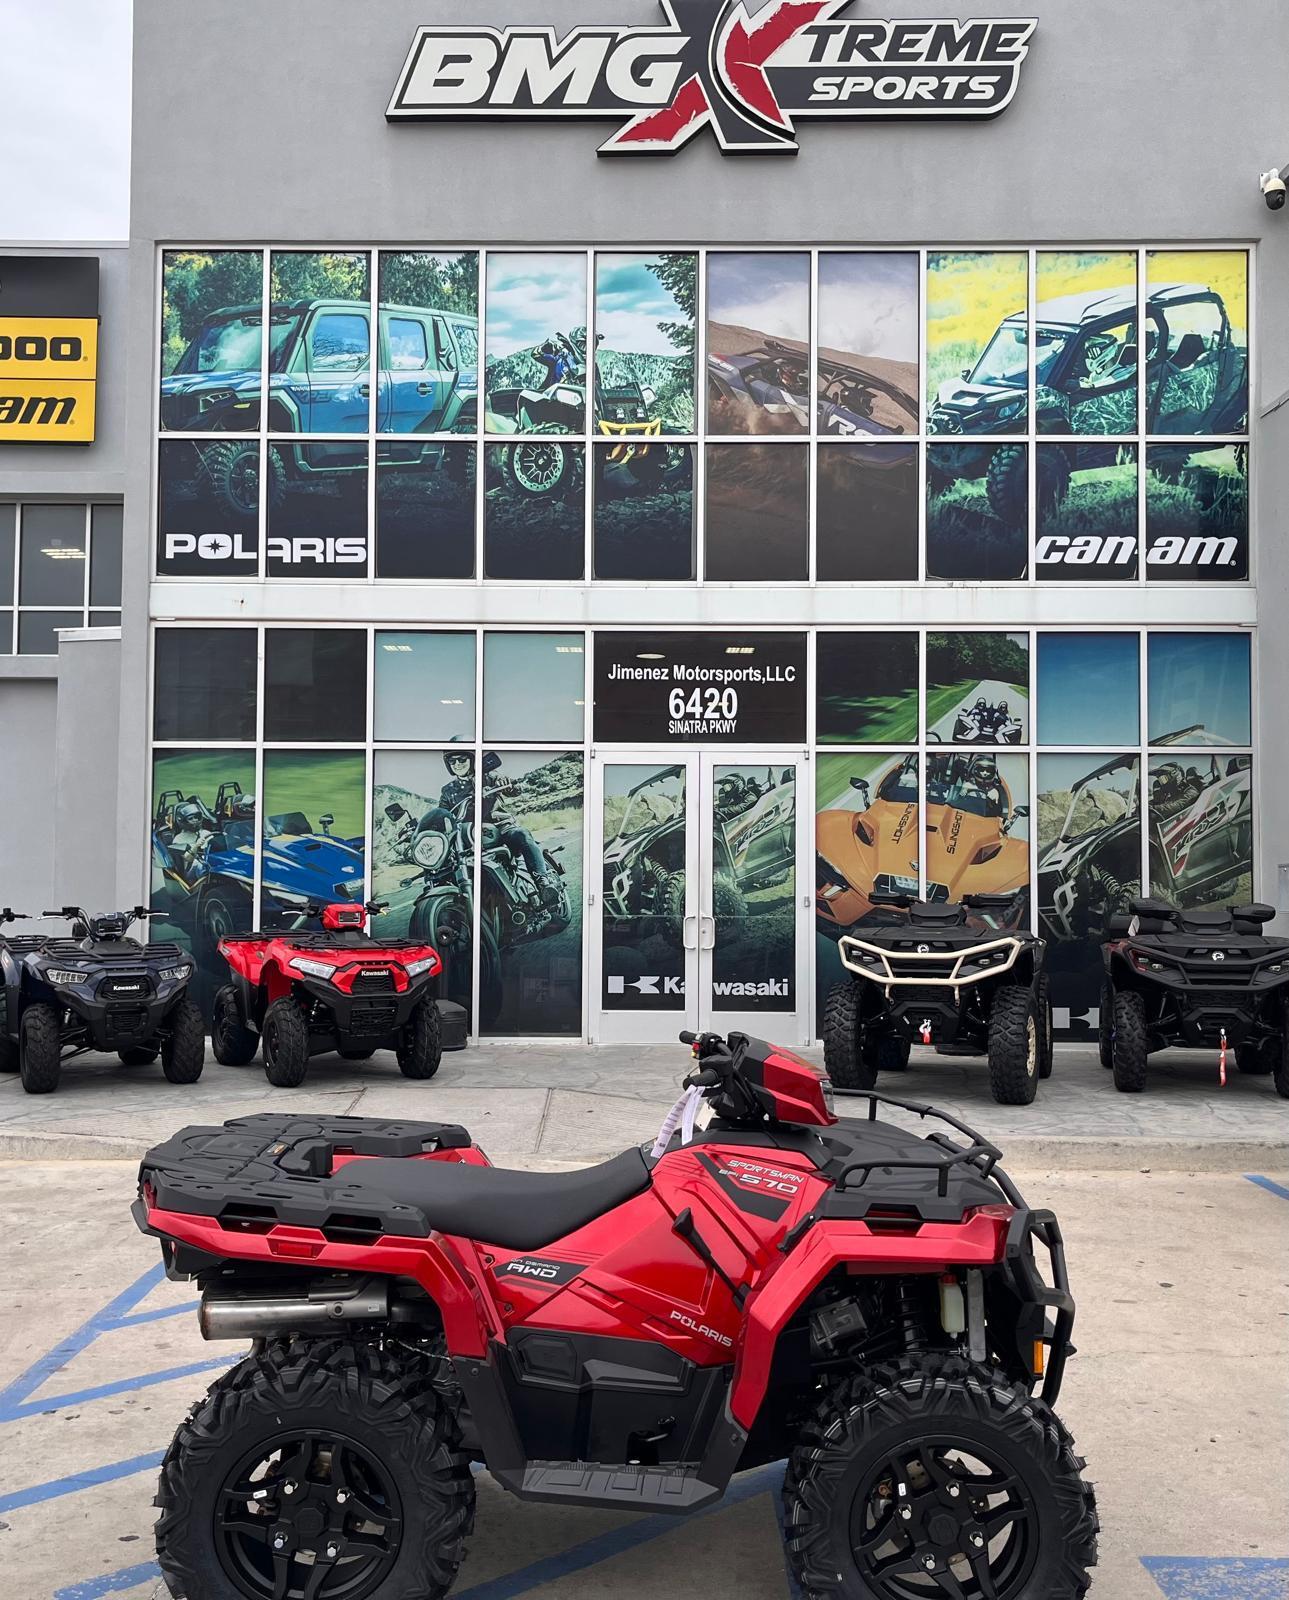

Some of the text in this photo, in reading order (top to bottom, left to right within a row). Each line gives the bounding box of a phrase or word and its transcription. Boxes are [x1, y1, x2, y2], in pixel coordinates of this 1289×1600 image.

[401, 36, 691, 104] BMG
[808, 76, 1002, 101] SPORTS
[165, 533, 367, 563] POLARIS
[608, 664, 796, 684] Jimenez Motorsports,LLC
[668, 687, 738, 719] 6420
[668, 719, 737, 734] SINATRA PKWY
[946, 811, 965, 854] SLINGSHOT
[727, 1160, 805, 1183] SPORTSMAN
[739, 1173, 798, 1194] 570
[506, 1263, 557, 1278] AWD
[670, 1311, 733, 1347] POLARIS
